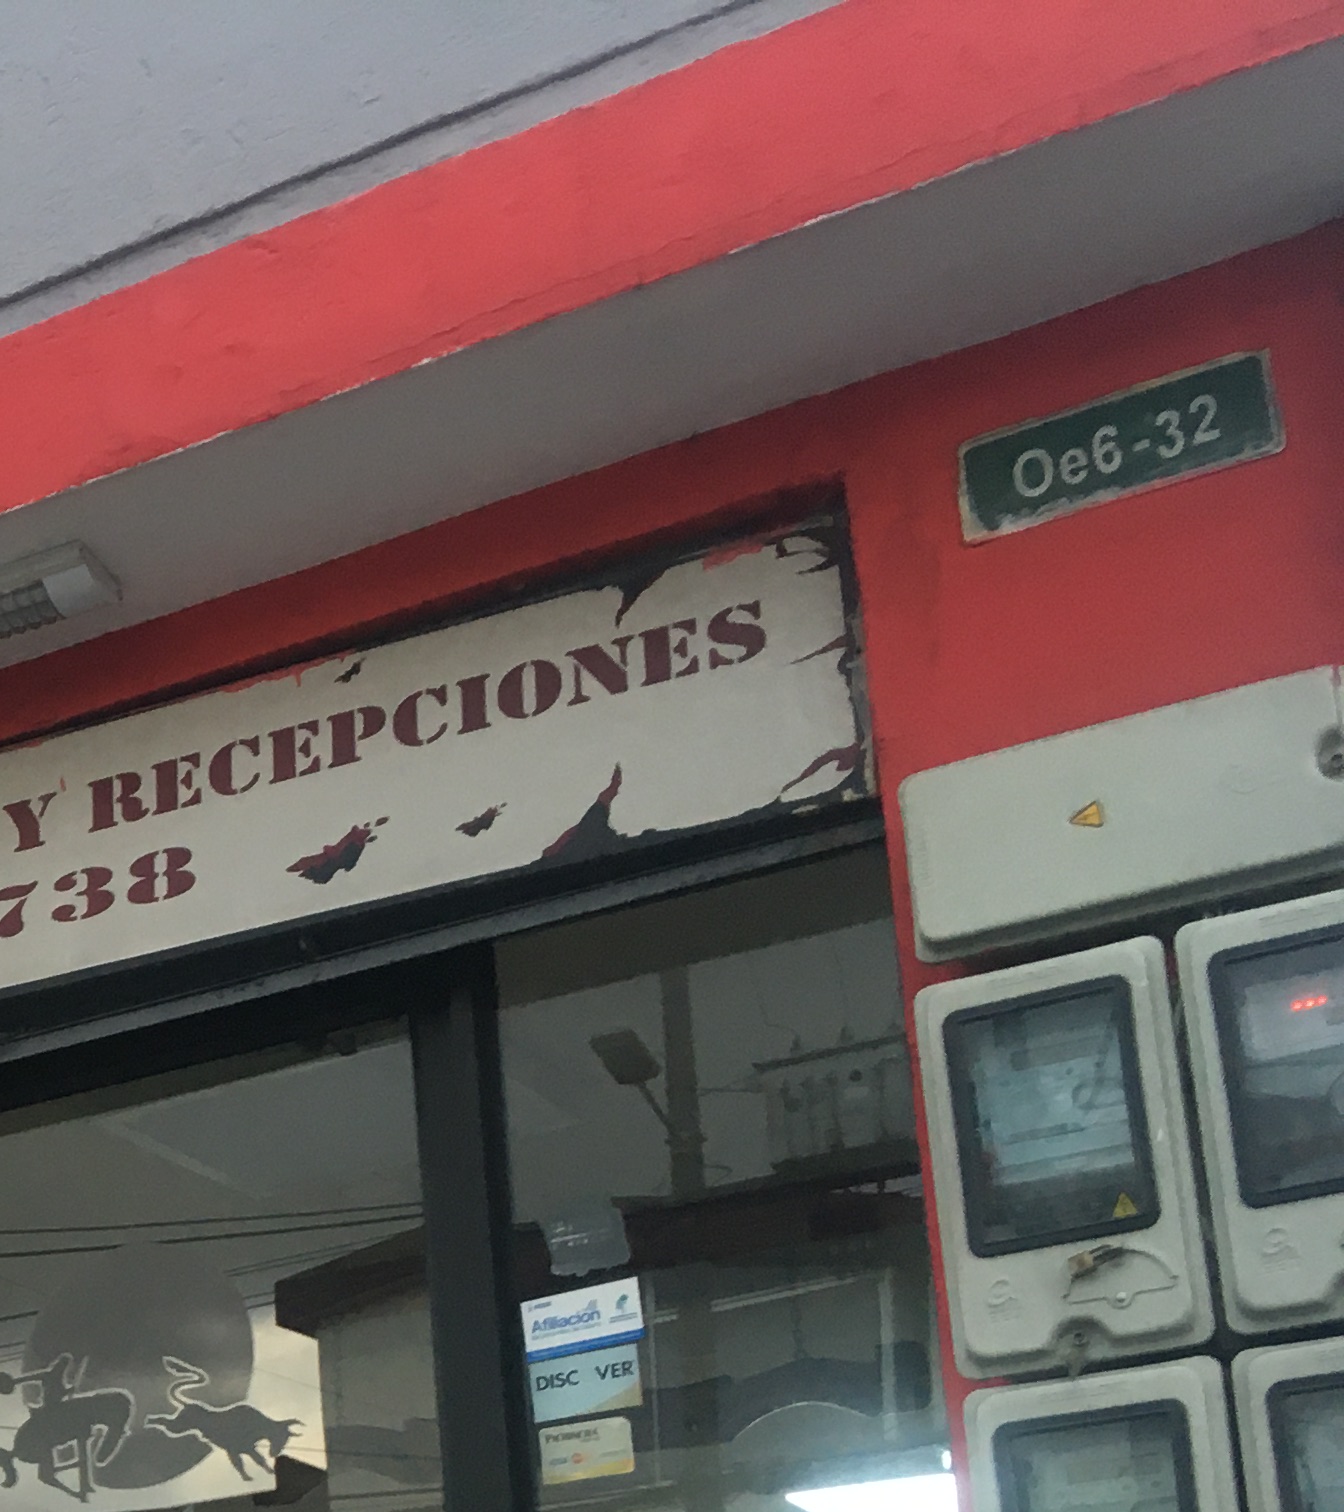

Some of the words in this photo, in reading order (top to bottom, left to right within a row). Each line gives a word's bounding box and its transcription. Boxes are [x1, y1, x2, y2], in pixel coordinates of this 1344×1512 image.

[1012, 394, 1222, 498] Oe6-32
[2, 790, 57, 853] Y
[88, 600, 768, 833] RECEPCIONES
